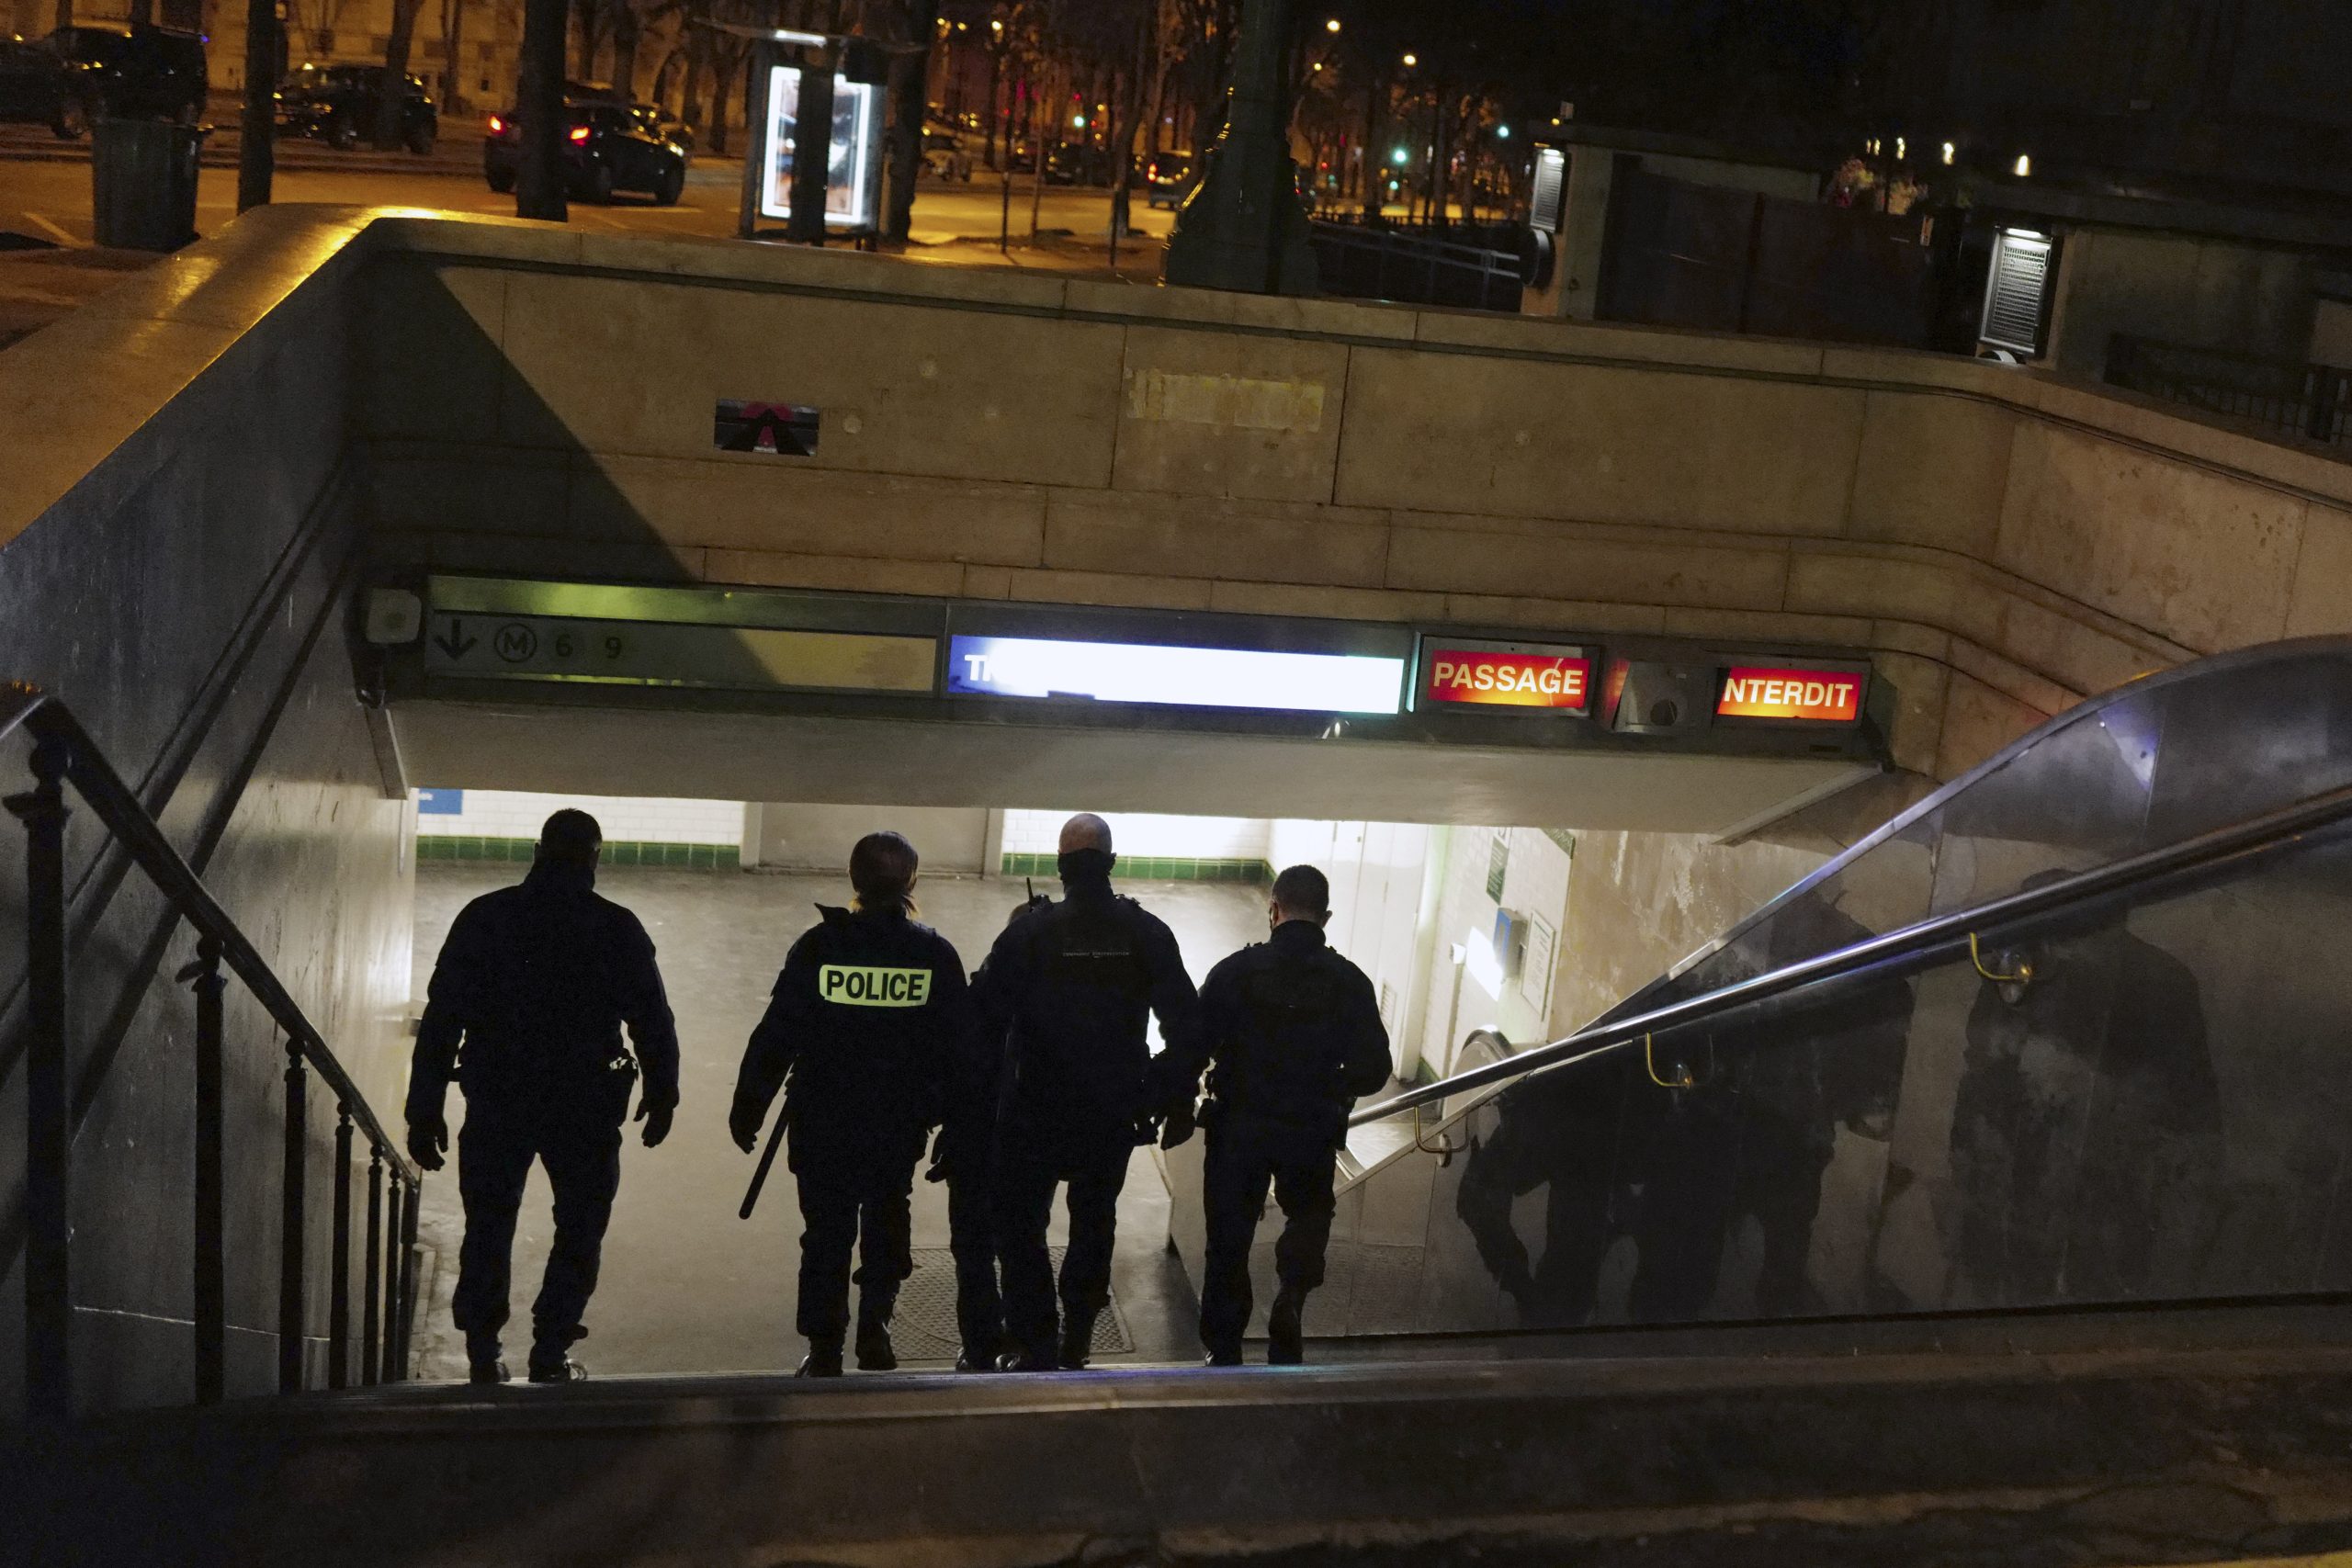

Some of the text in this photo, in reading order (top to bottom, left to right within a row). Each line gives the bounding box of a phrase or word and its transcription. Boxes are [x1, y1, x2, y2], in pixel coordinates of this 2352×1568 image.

[556, 634, 573, 657] 6
[605, 637, 622, 659] 9
[1433, 662, 1582, 694] PASSAGE
[1724, 678, 1852, 707] NTERDIT
[827, 970, 924, 1000] POLICE
